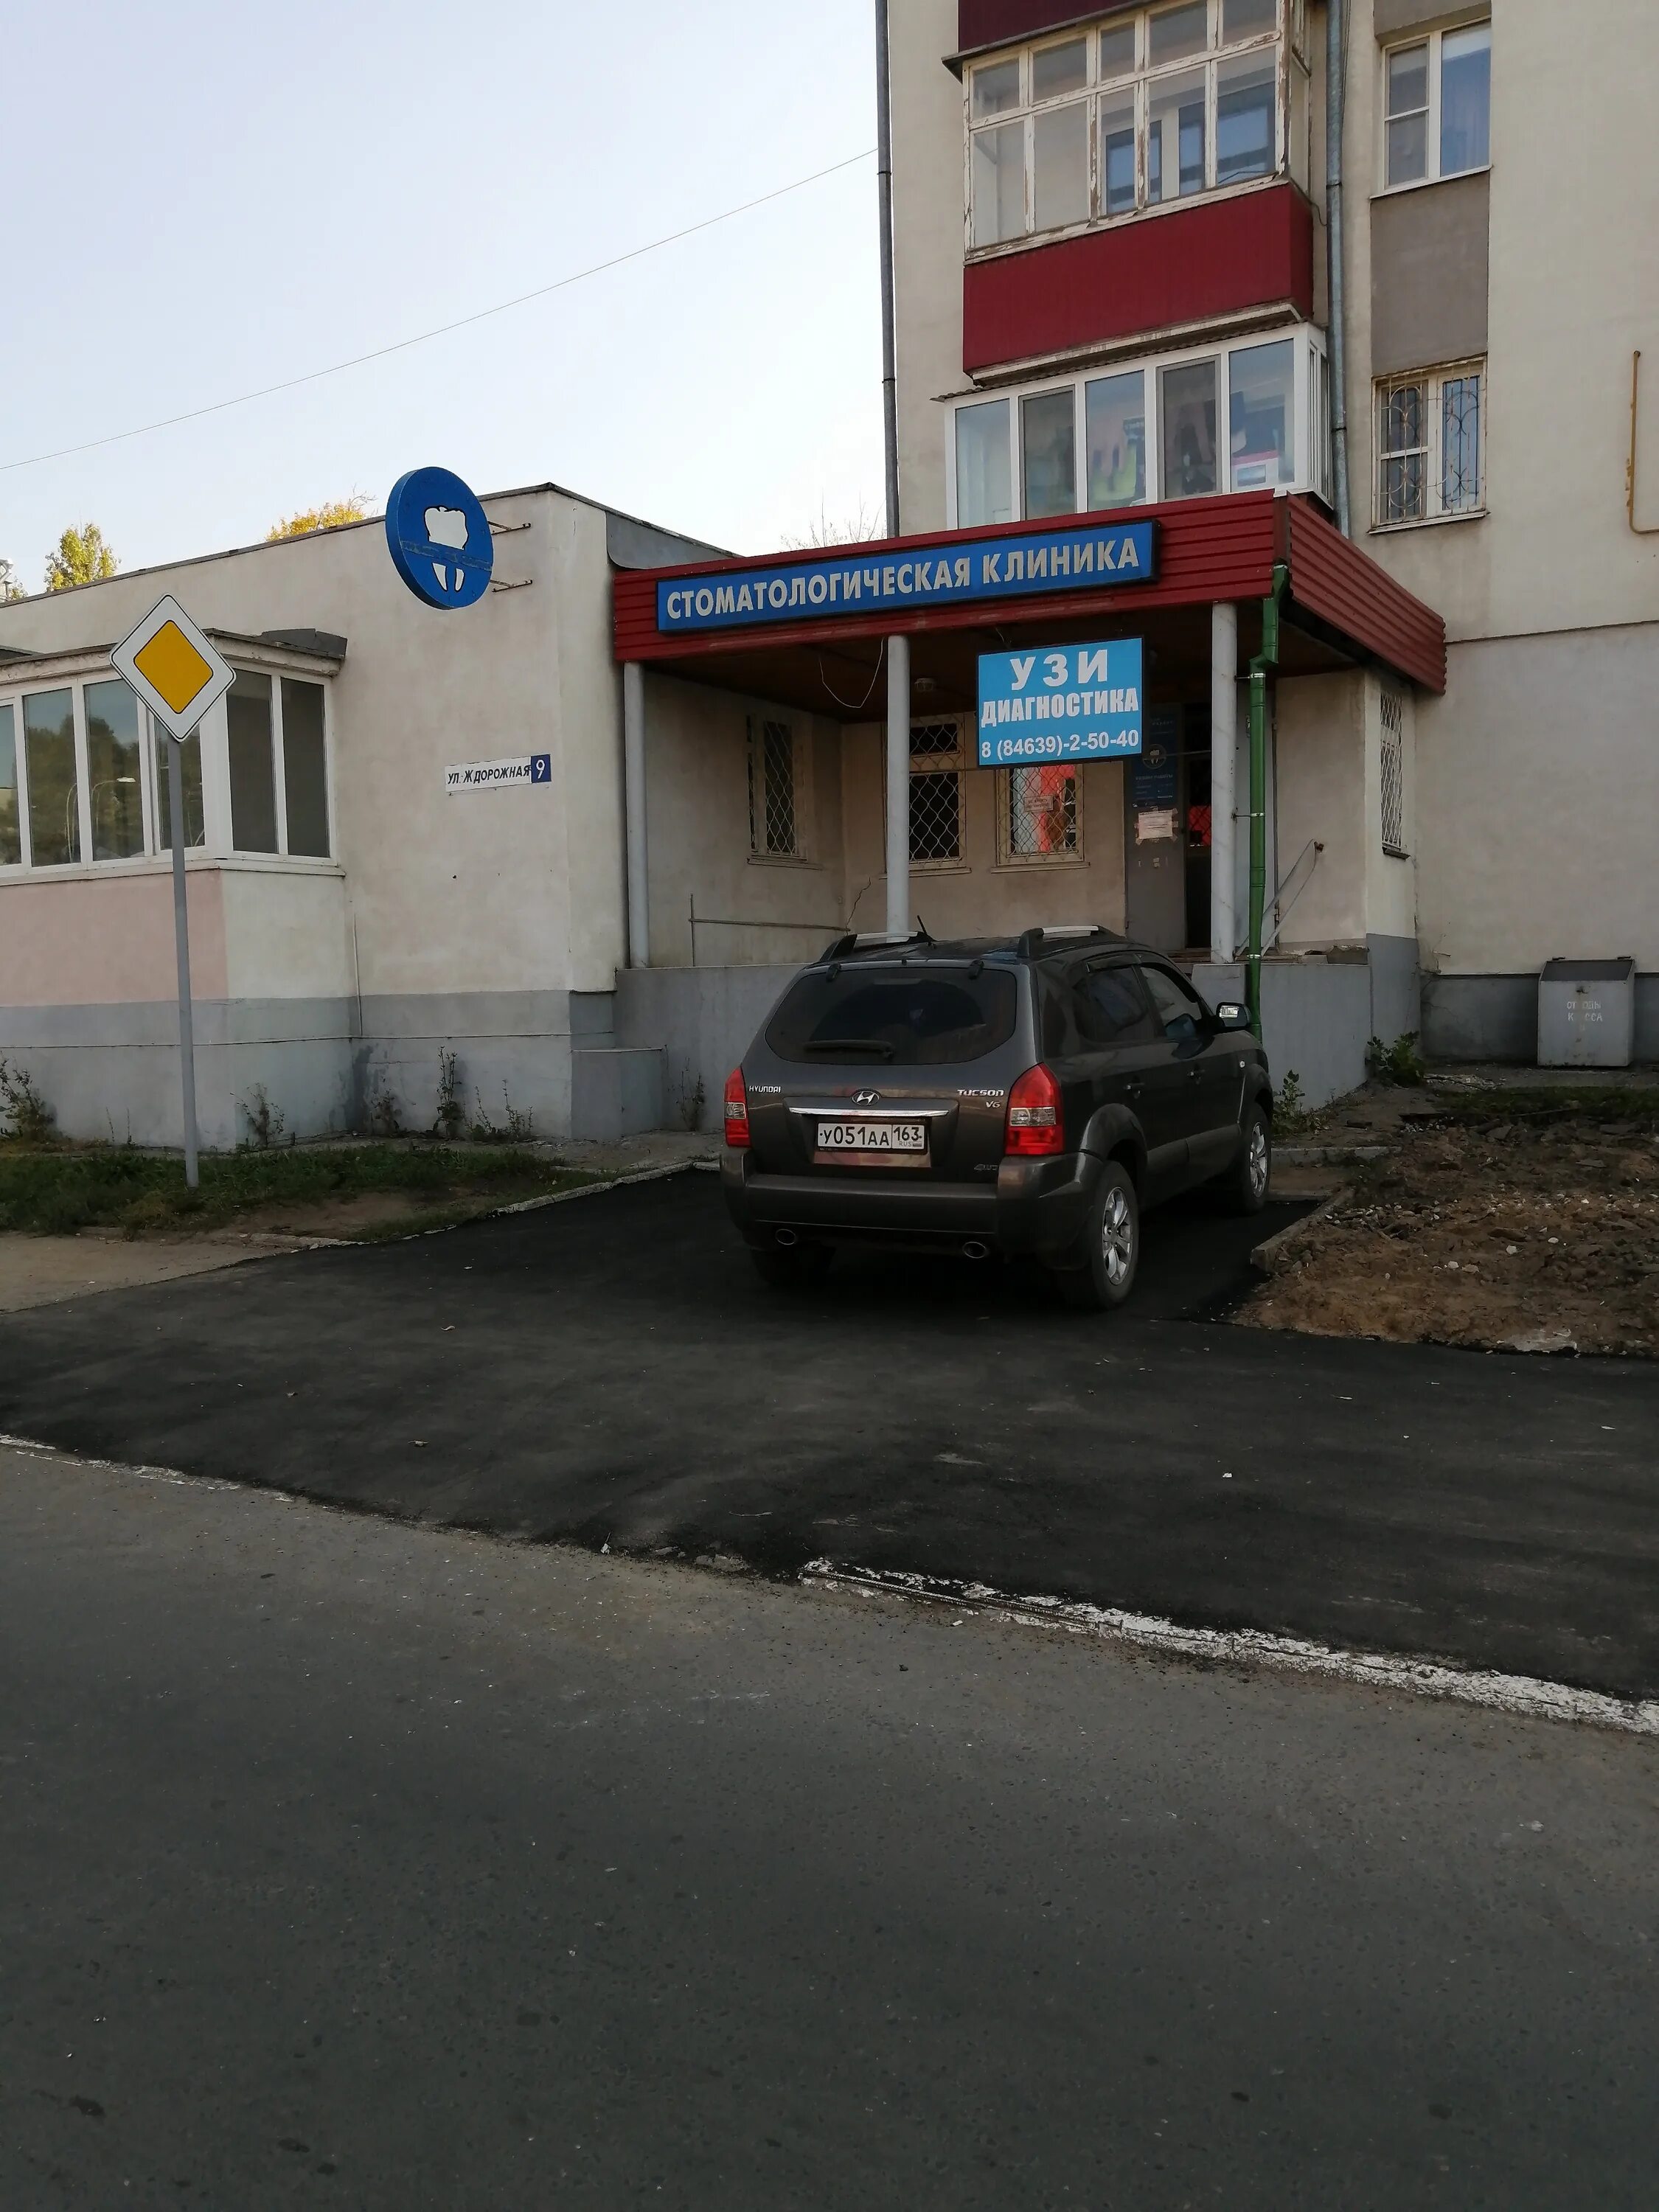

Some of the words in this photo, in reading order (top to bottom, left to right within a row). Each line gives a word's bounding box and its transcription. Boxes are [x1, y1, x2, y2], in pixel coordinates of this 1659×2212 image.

[667, 557, 970, 619] СТОМАТОЛОГИЧЕСКАЯ
[982, 538, 1139, 584] КЛИНИКА
[1009, 649, 1108, 691] УЗИ
[981, 687, 1139, 728] ДИАГНОСТИКА
[981, 742, 991, 758] 8
[997, 729, 1139, 761] (84639)-2-50-40
[535, 759, 546, 779] 9
[748, 1085, 782, 1093] HYUNDAI
[893, 1127, 919, 1141] 163
